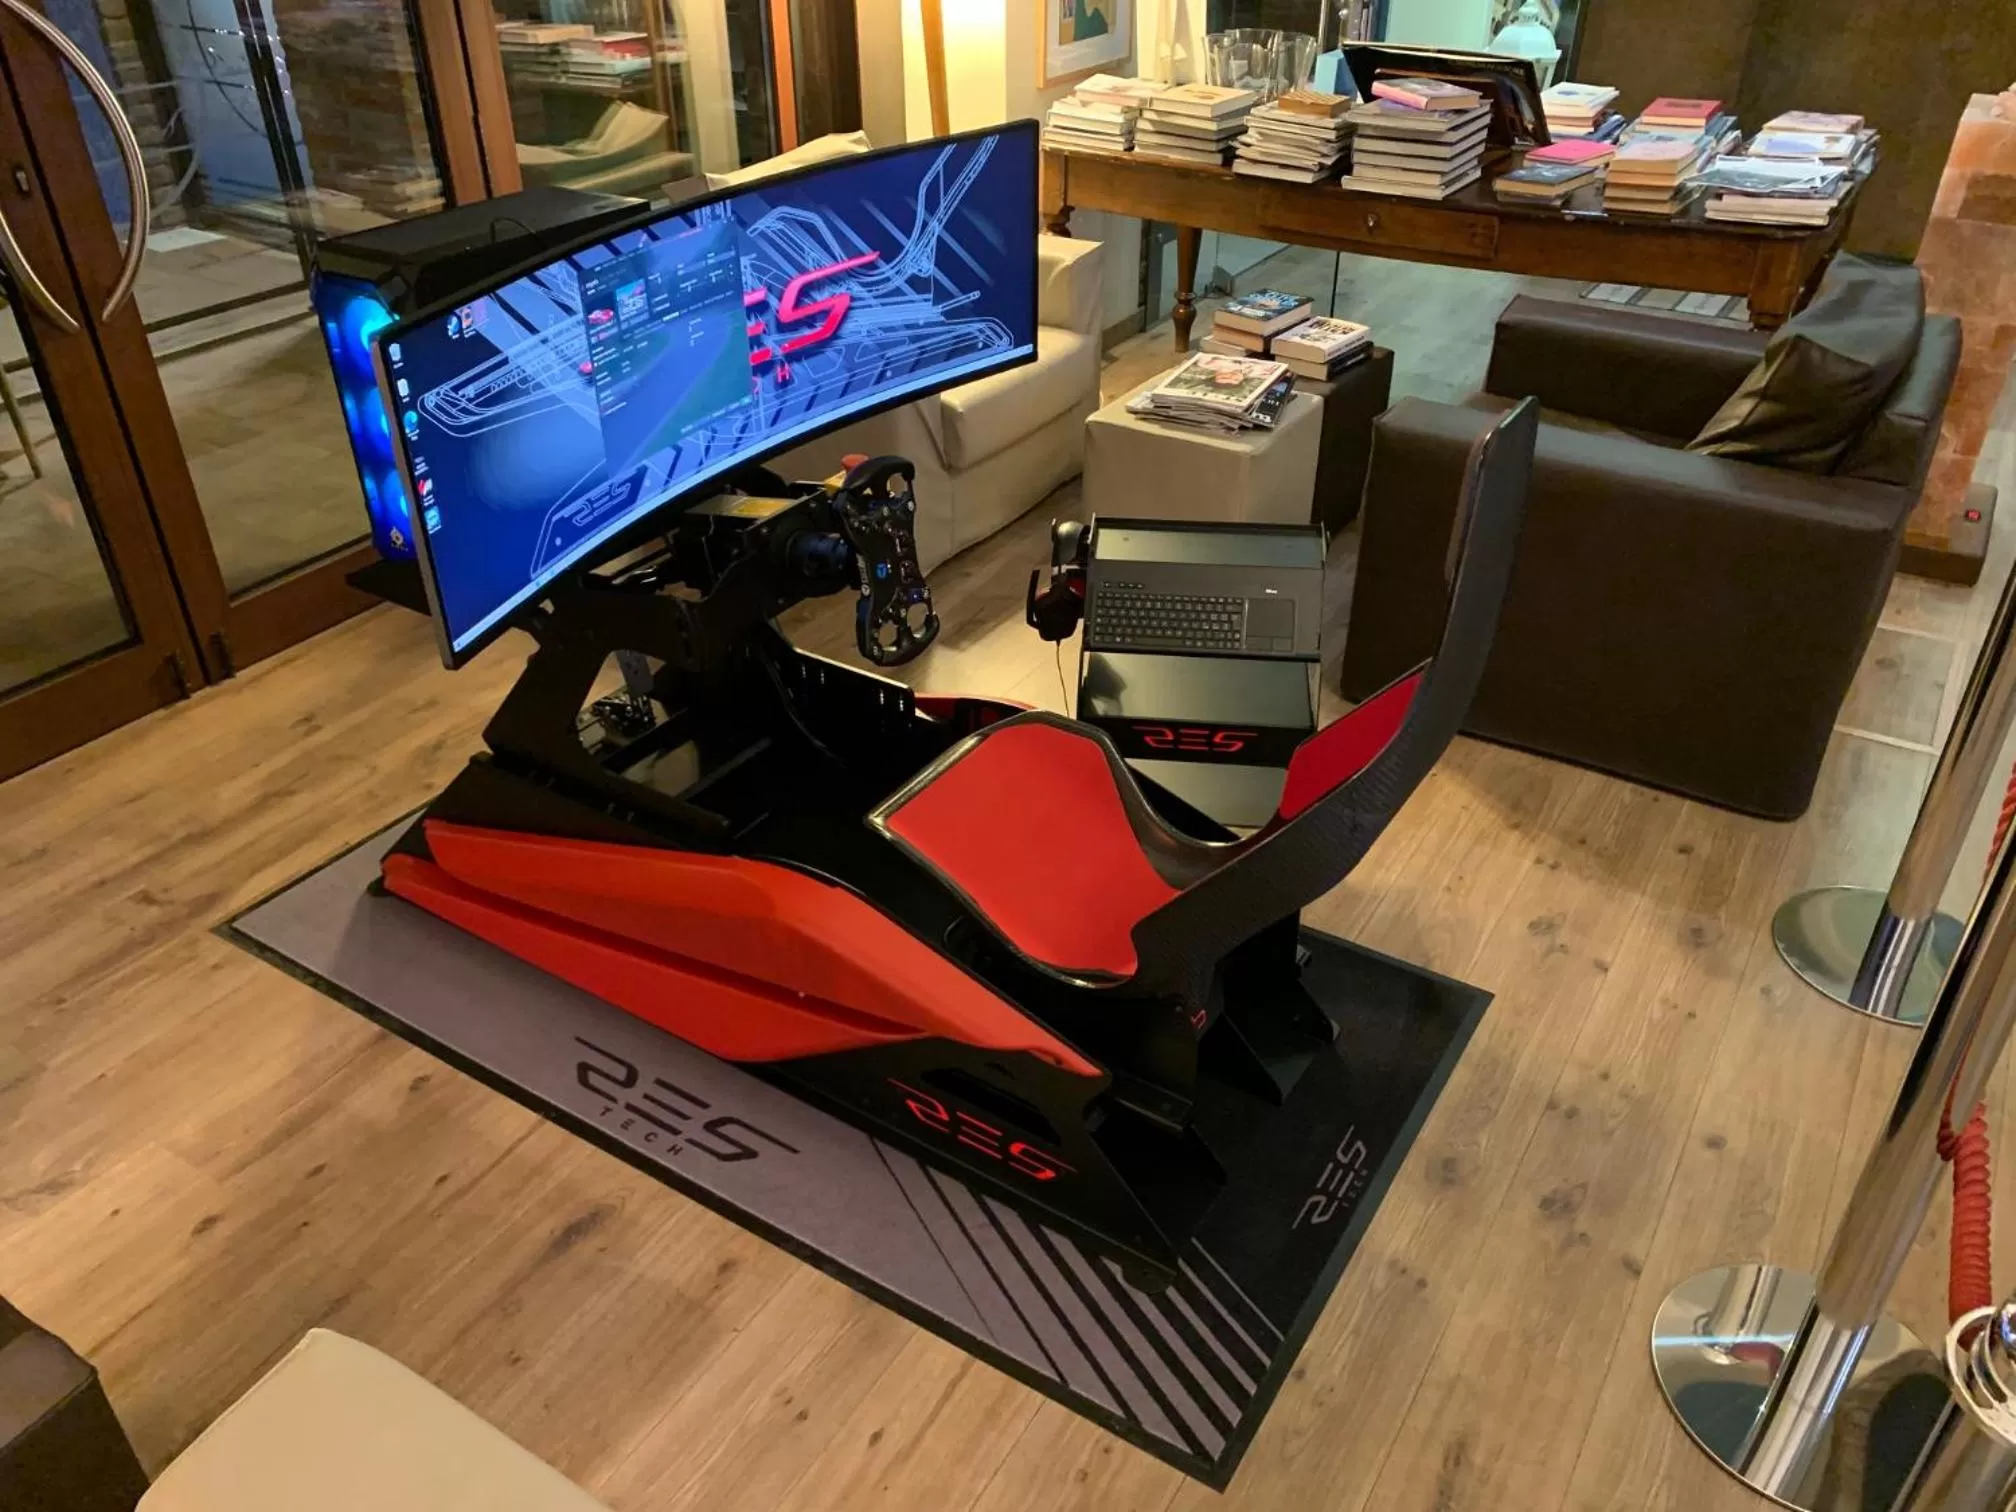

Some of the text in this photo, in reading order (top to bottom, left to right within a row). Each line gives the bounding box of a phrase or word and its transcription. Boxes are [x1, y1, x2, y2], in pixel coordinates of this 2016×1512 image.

[1131, 725, 1259, 752] RES
[574, 1035, 801, 1162] RES
[599, 1105, 684, 1157] TECH
[885, 1076, 1079, 1181] RES
[1291, 1123, 1367, 1230] RES
